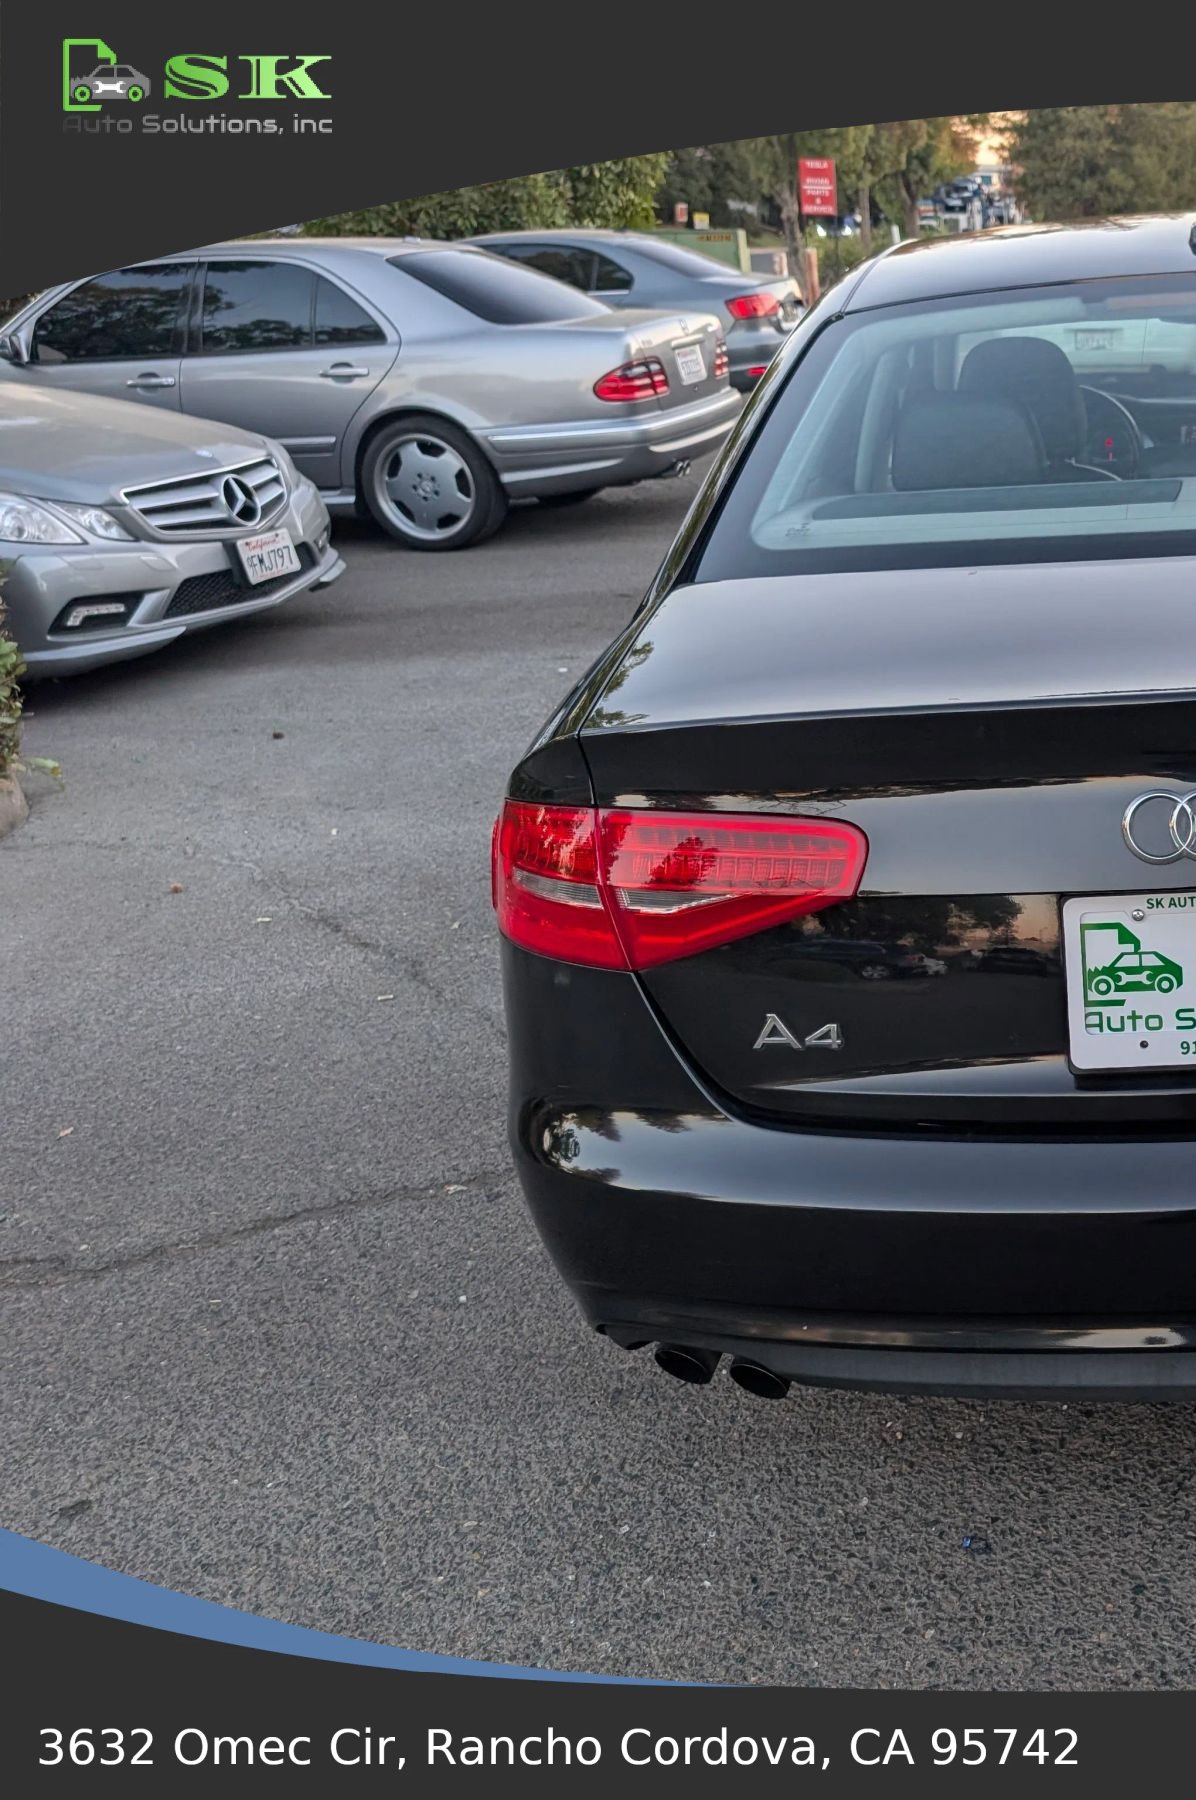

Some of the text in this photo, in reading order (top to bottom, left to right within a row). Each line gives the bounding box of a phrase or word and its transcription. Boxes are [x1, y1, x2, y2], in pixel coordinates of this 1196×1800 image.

[246, 545, 293, 577] 9FMJ797
[1146, 897, 1165, 909] SK
[752, 1013, 842, 1049] A4
[1085, 1008, 1164, 1033] Auto
